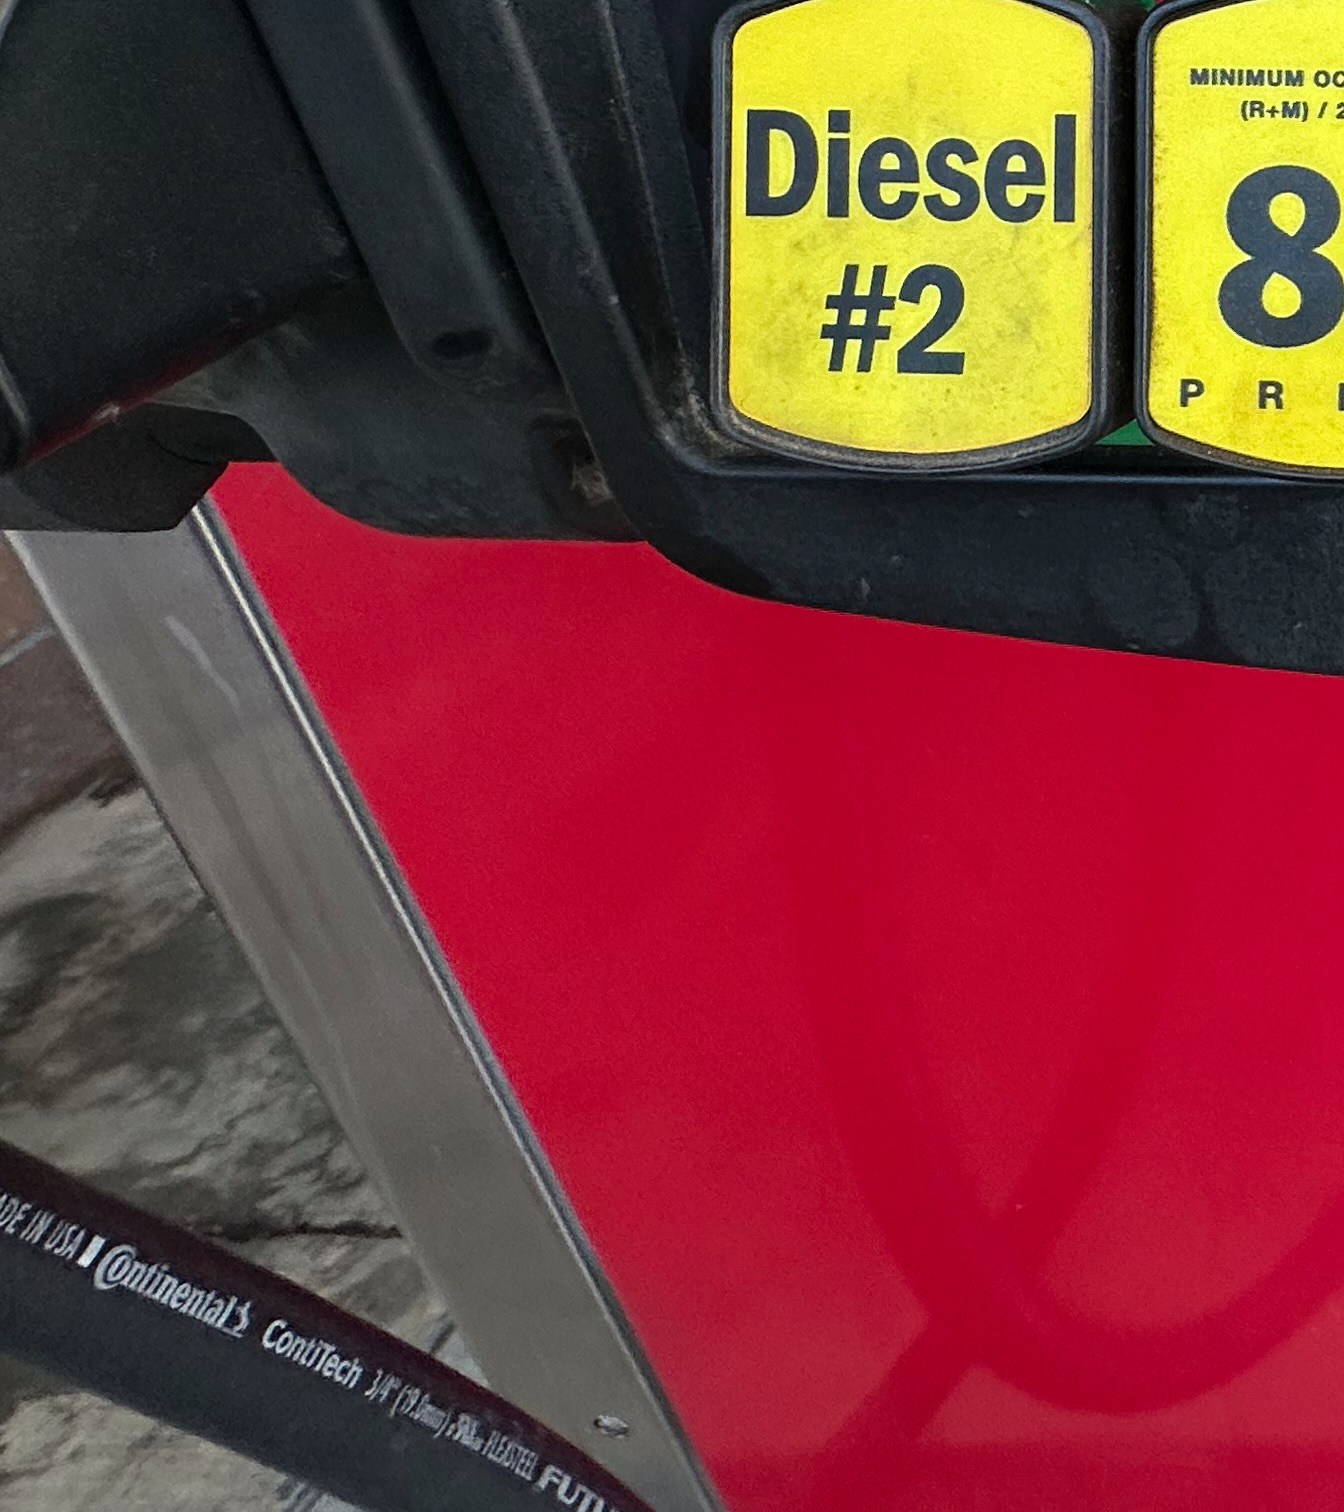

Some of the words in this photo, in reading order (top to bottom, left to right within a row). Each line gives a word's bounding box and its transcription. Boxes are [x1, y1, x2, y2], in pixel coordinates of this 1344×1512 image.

[1190, 68, 1305, 89] MINIMUM
[1240, 99, 1309, 124] (R+M)
[744, 108, 1076, 225] Diesel
[819, 262, 966, 376] #2
[0, 1193, 32, 1234] DE
[20, 1209, 58, 1244] IN
[43, 1219, 86, 1260] USA
[94, 1244, 240, 1333] Continental
[262, 1319, 364, 1389] ContiTech
